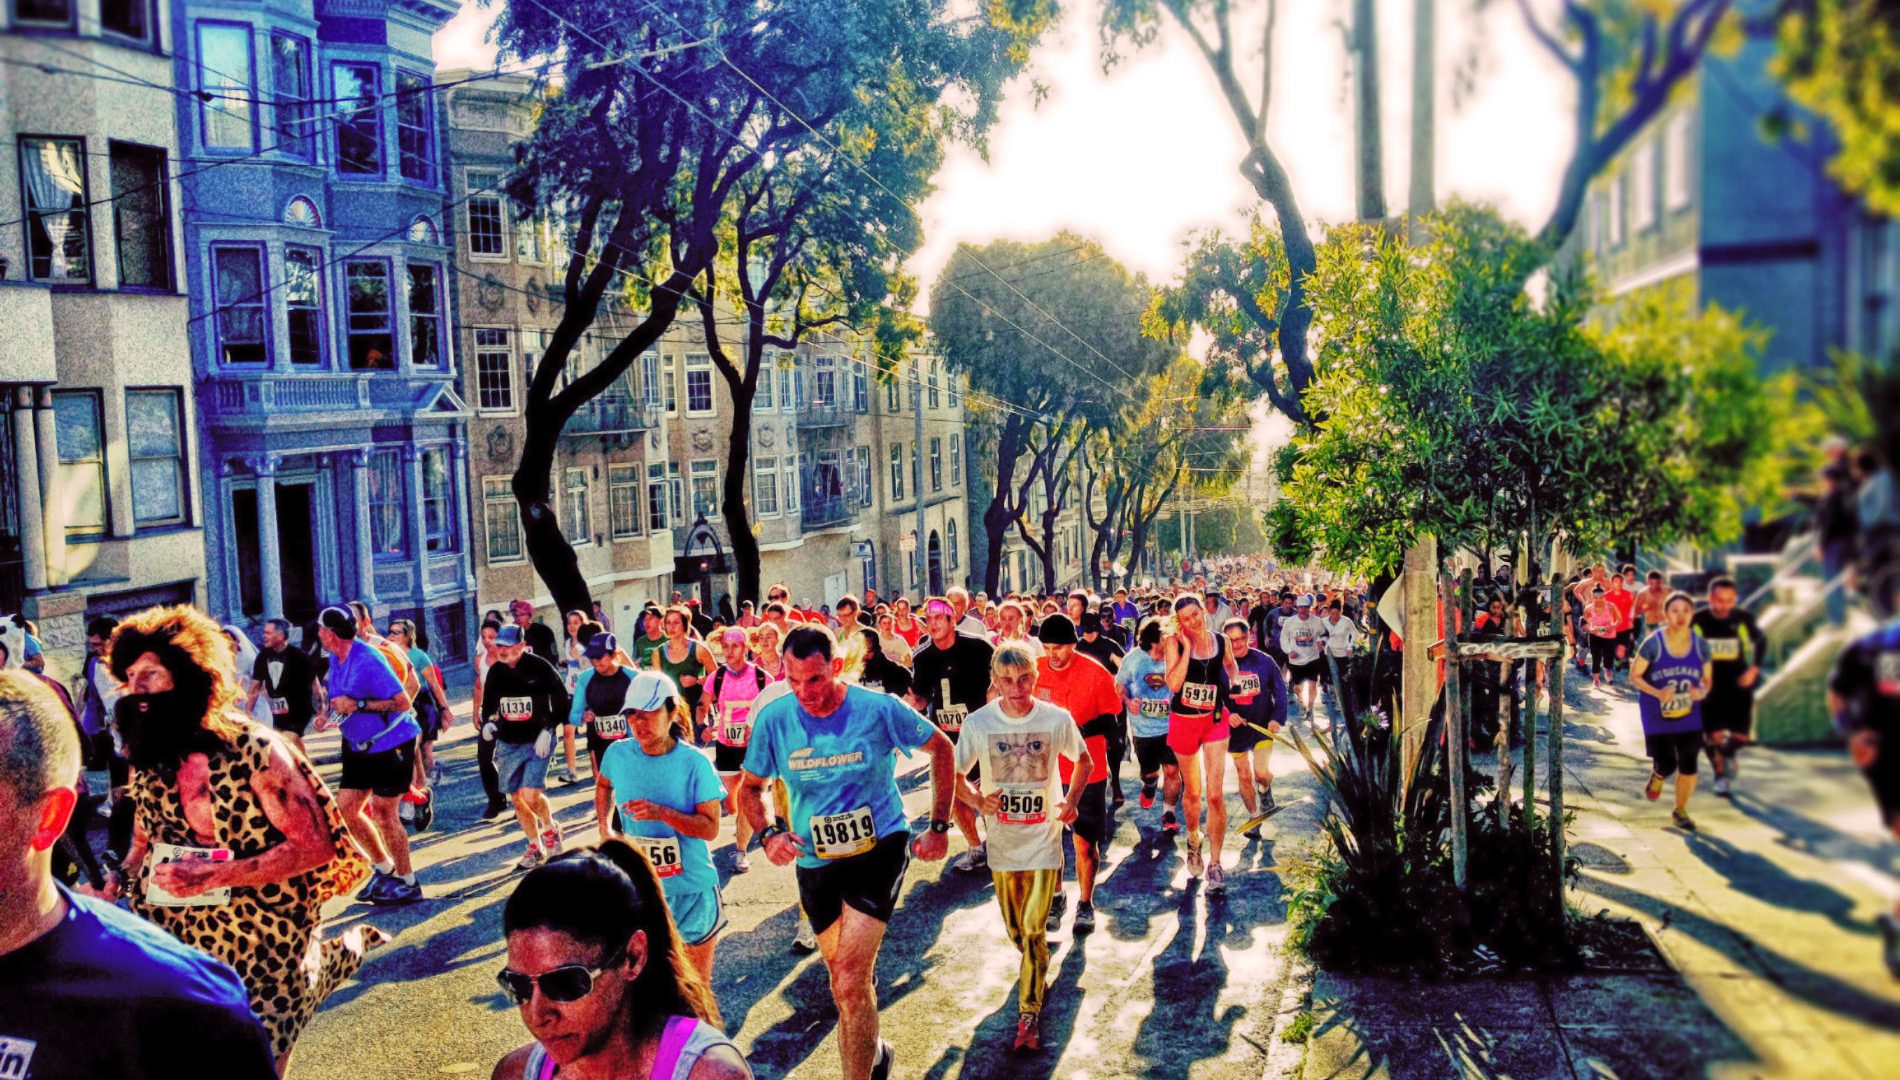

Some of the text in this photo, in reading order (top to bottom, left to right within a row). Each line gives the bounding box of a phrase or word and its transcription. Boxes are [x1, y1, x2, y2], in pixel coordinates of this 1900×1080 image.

[1184, 687, 1214, 702] 5934
[501, 702, 531, 714] 11334
[1142, 702, 1169, 714] 23753
[595, 720, 624, 733] 11340
[790, 751, 863, 770] WILDFLOWER
[813, 815, 874, 846] 19819
[641, 845, 676, 866] 56
